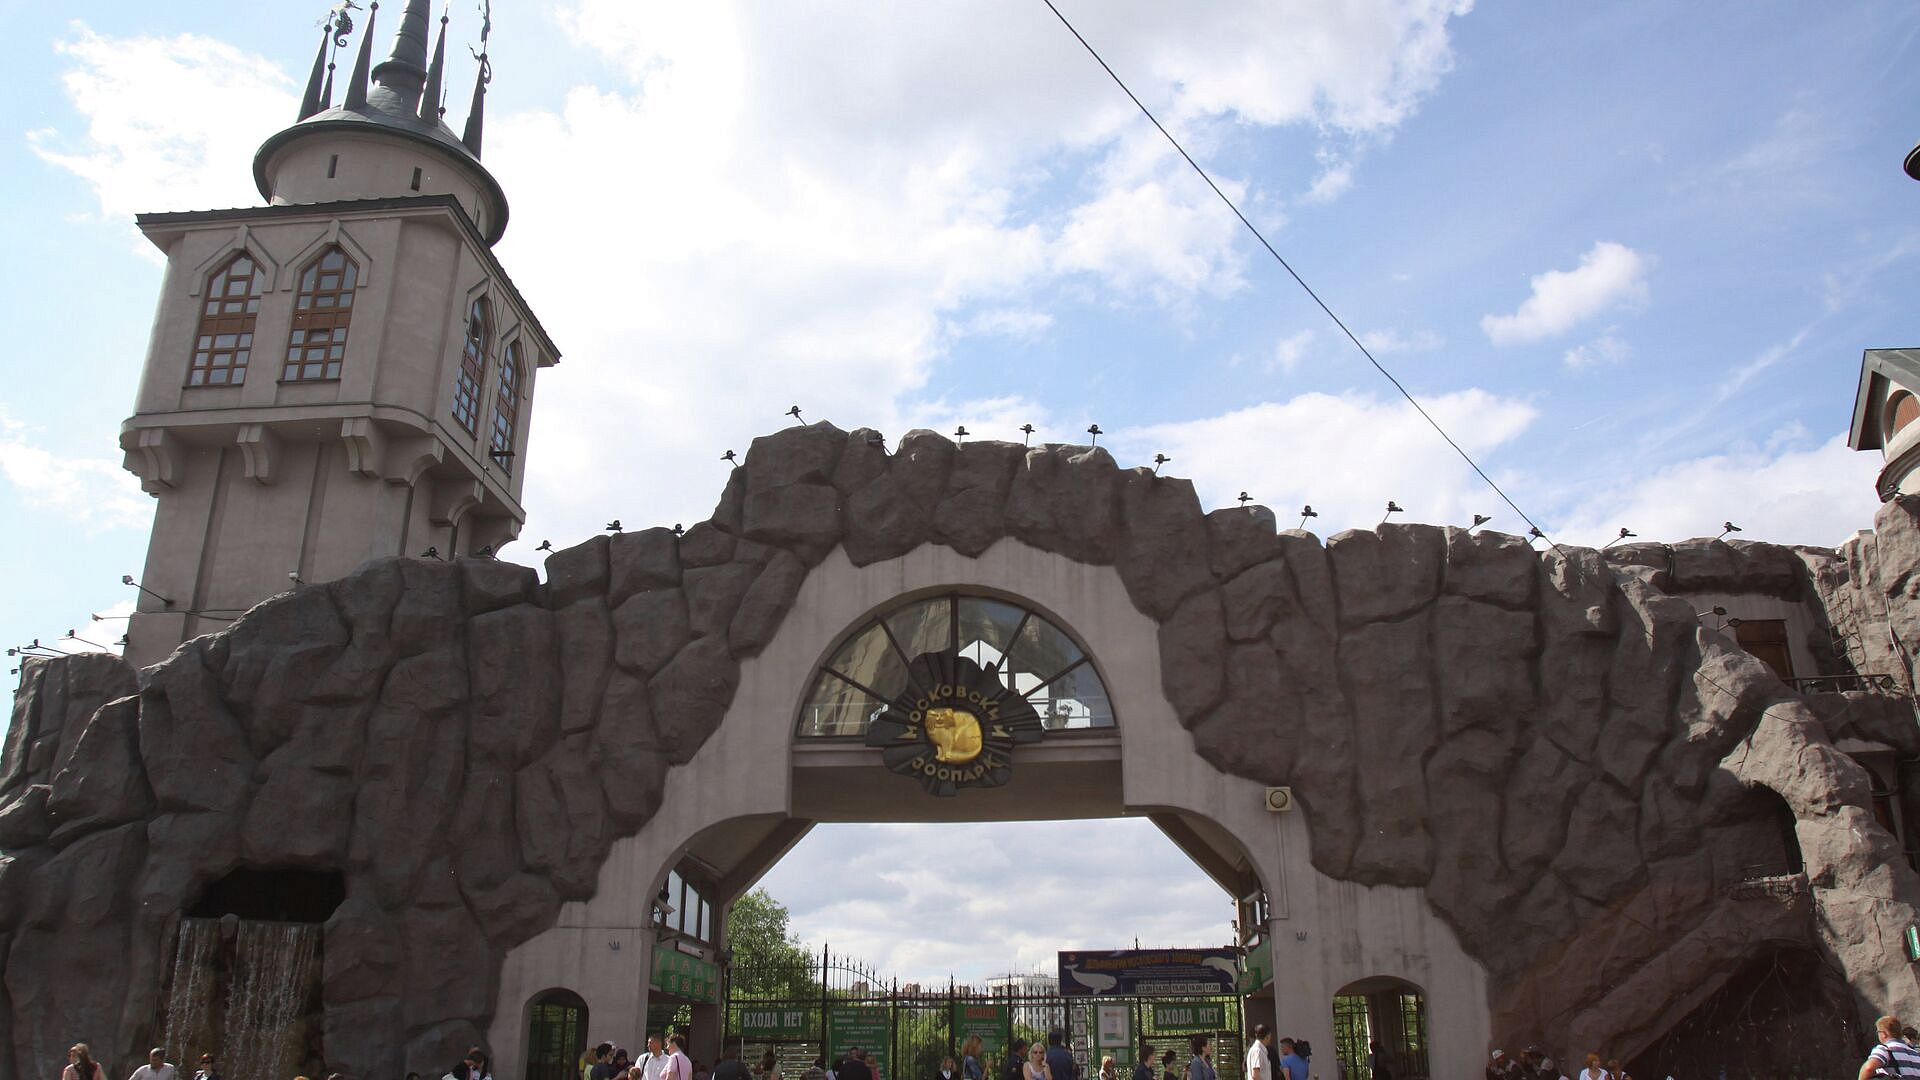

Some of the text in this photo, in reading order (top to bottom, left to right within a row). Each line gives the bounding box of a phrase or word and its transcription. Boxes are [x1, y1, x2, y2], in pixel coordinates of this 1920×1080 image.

[897, 683, 1014, 739] МОСКОВСКИЙ
[912, 754, 1004, 782] ЗООПАРК
[743, 1011, 803, 1028] ВХОДА НЕТ
[1157, 1007, 1220, 1025] ВХОДА НЕТ
